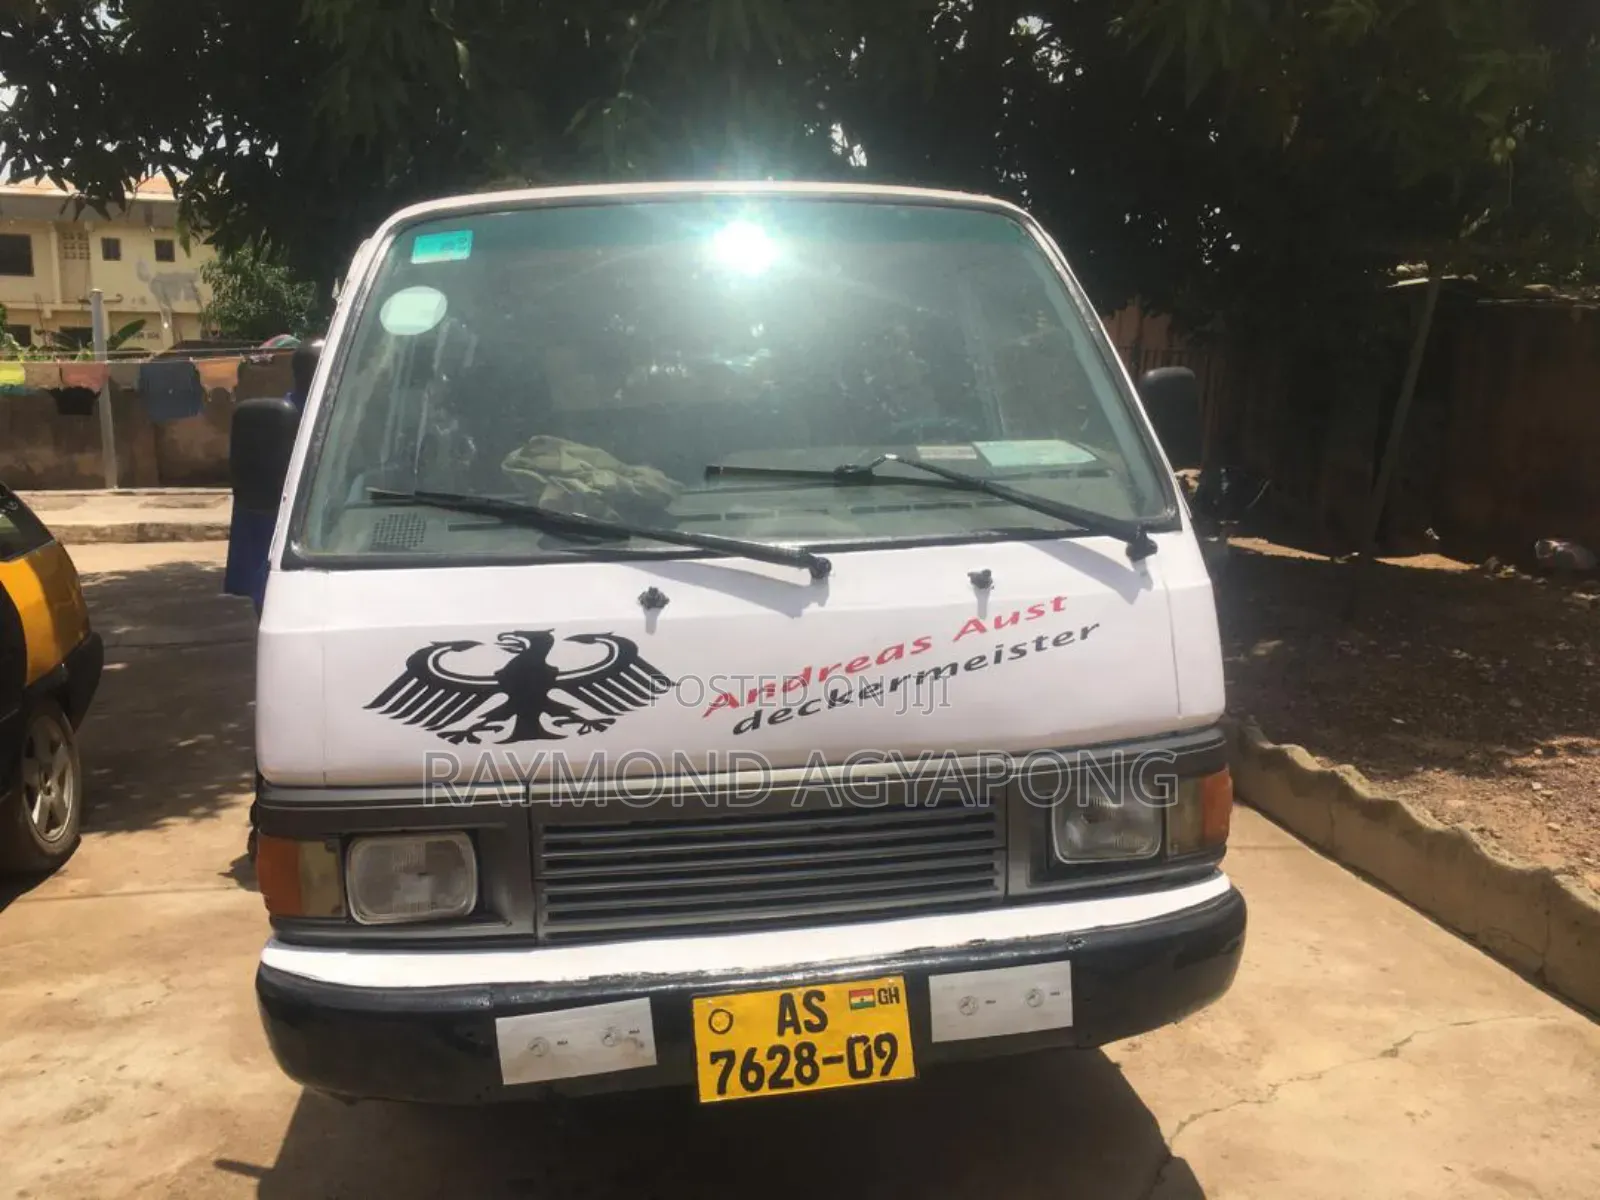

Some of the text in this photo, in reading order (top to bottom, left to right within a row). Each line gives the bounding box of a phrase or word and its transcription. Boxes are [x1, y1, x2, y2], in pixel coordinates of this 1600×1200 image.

[703, 595, 1068, 717] Andreas Aust
[732, 621, 1101, 735] deckermeister
[777, 990, 829, 1037] AS
[878, 987, 900, 1005] GH
[710, 1032, 898, 1095] 7628-09
